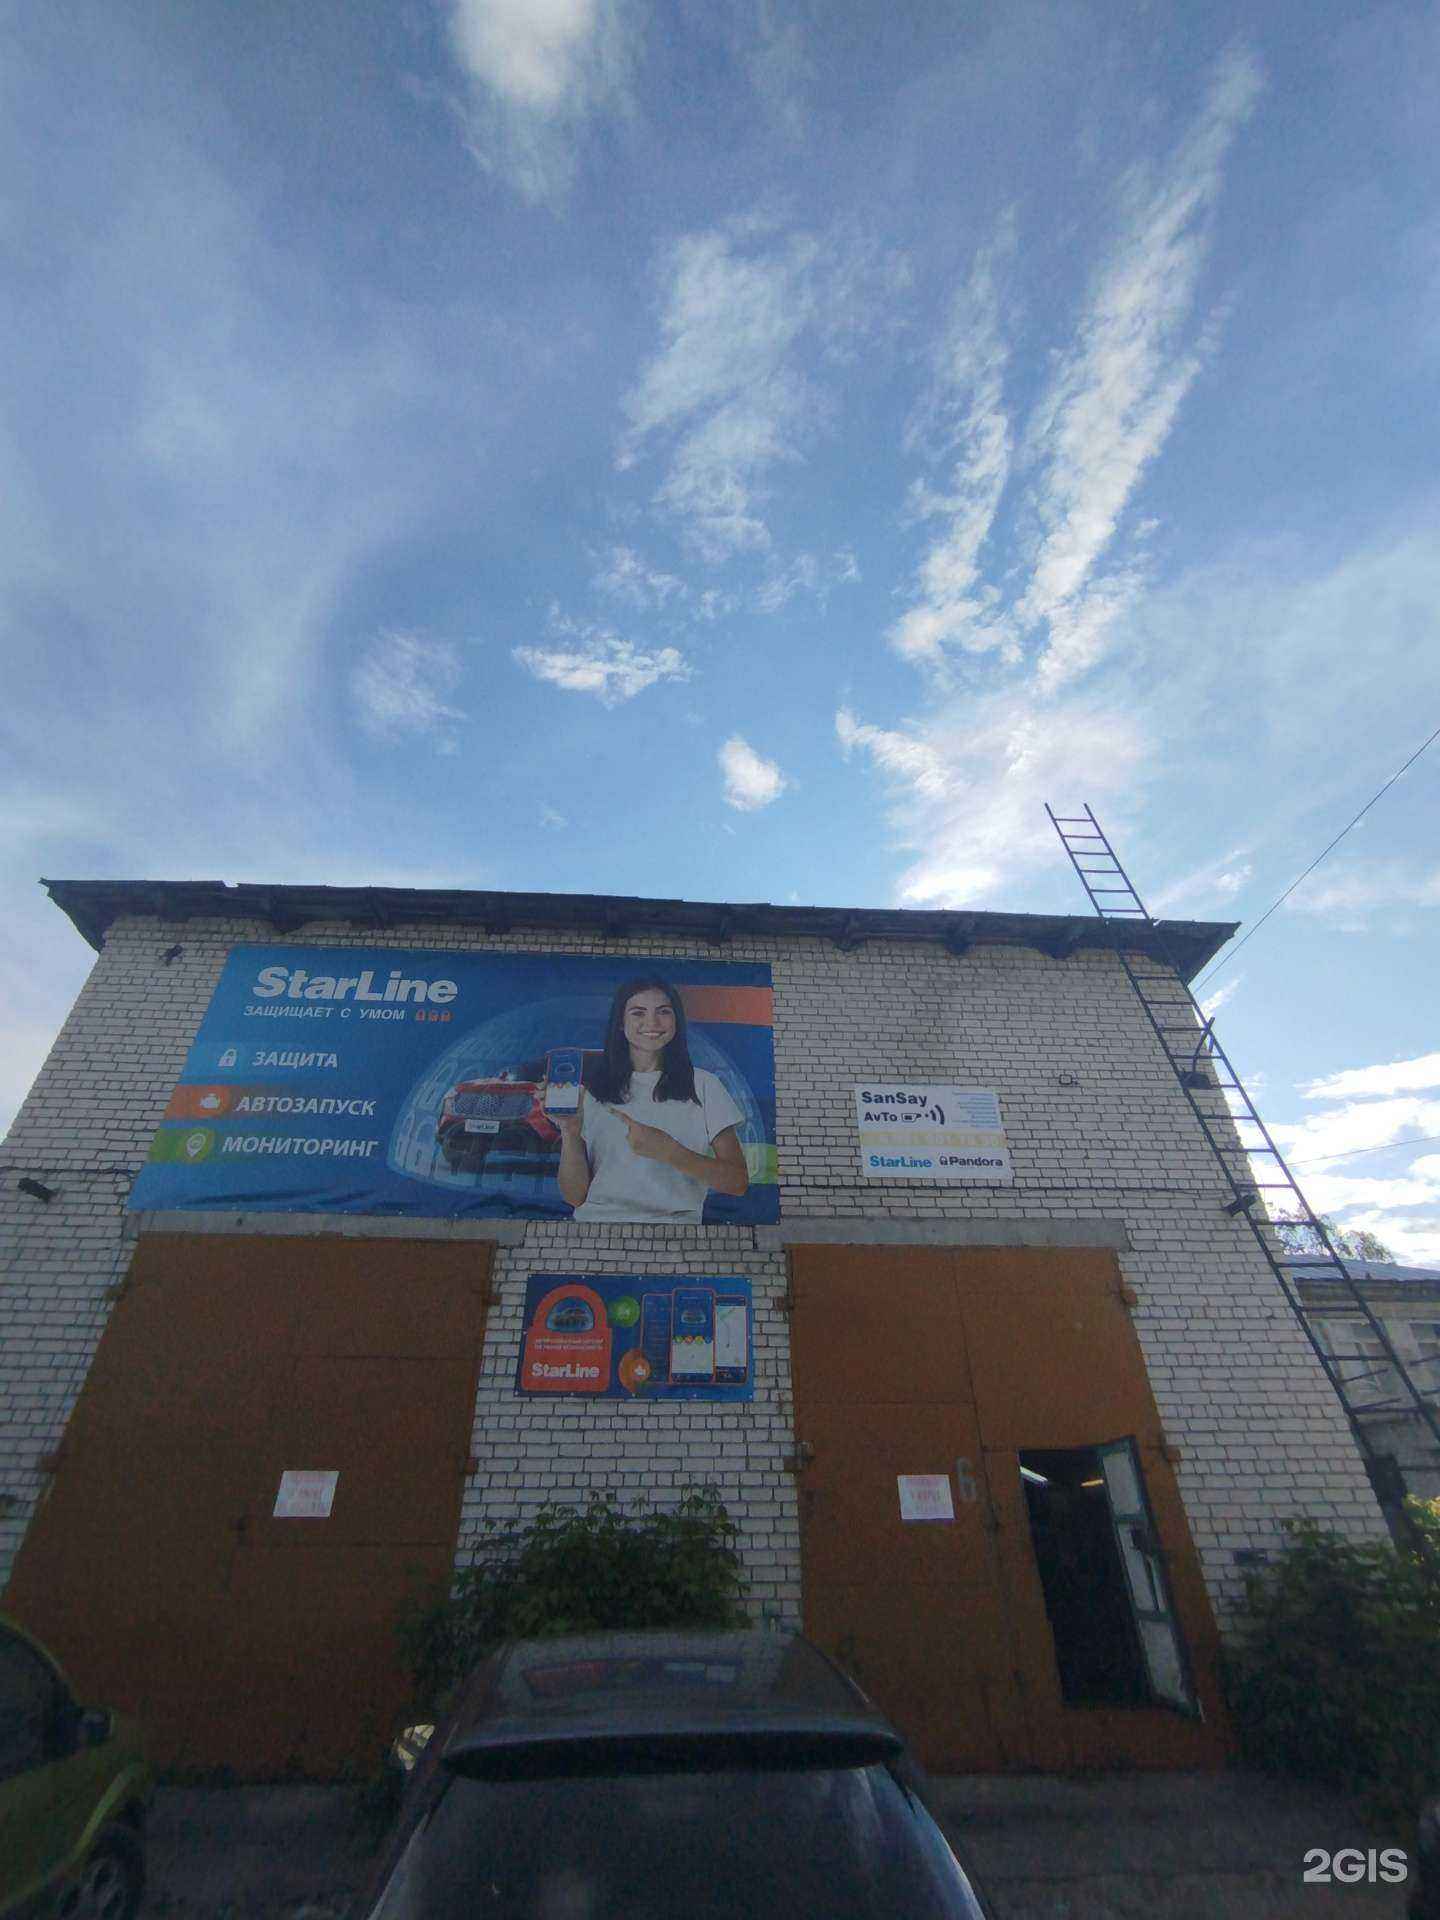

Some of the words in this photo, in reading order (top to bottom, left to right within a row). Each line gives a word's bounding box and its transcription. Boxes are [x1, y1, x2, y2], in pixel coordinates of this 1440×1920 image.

[252, 966, 458, 1003] StarLine
[243, 1005, 334, 1020] ЗАЩИЩАЕТ
[340, 1007, 352, 1020] С
[359, 1008, 405, 1021] УМОМ
[251, 1051, 339, 1069] ЗАЩИТА
[235, 1096, 377, 1117] АВТОЗАПУСК
[861, 1091, 928, 1107] SanSay
[221, 1136, 379, 1158] МОНИТОРИНГ
[869, 1155, 933, 1168] StarLine
[949, 1156, 1004, 1167] Pandora
[531, 1362, 600, 1378] StarLine
